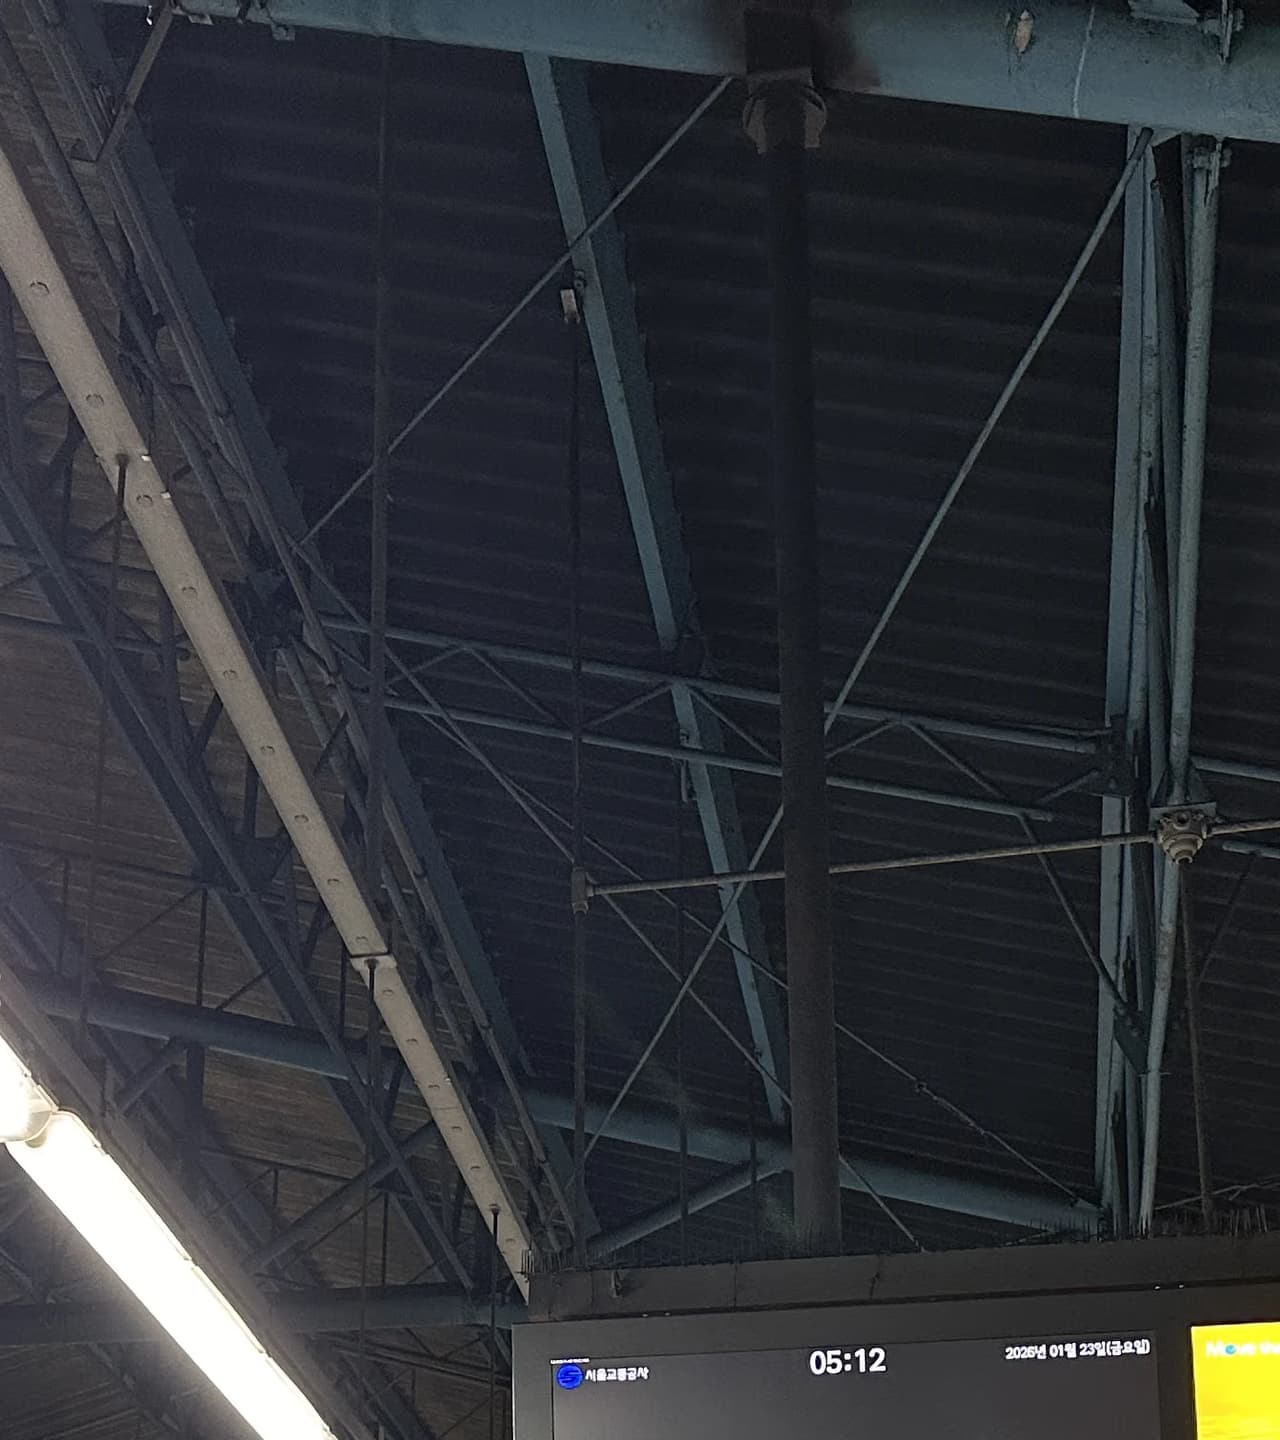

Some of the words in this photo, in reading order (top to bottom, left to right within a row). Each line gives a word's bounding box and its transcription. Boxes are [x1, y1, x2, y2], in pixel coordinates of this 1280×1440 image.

[809, 1346, 887, 1375] 05:12
[1005, 1344, 1047, 1360] 2026년
[1049, 1342, 1077, 1358] 01월
[1079, 1338, 1150, 1356] 23일(금요일)
